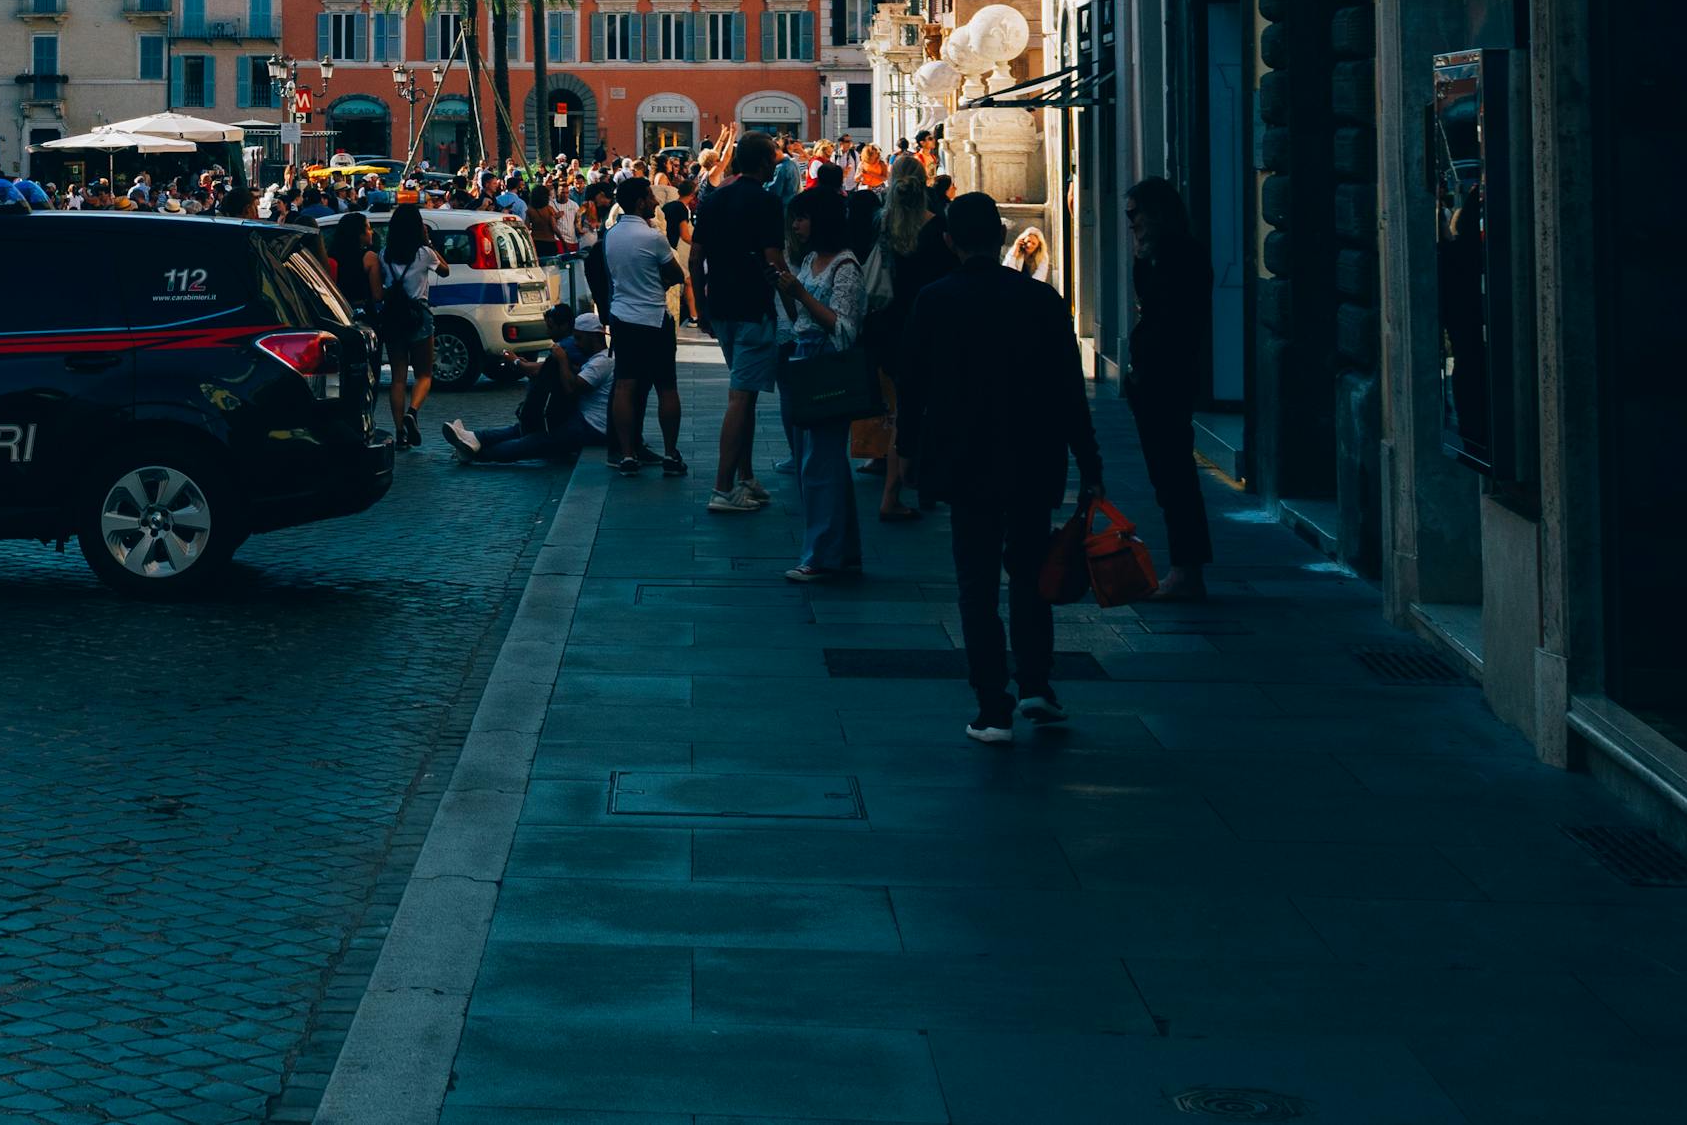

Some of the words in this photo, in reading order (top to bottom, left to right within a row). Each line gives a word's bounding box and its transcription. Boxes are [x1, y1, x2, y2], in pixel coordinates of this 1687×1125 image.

[342, 107, 377, 115] ESCADA
[163, 268, 208, 292] 112
[152, 294, 217, 302] www.carabinieri.it
